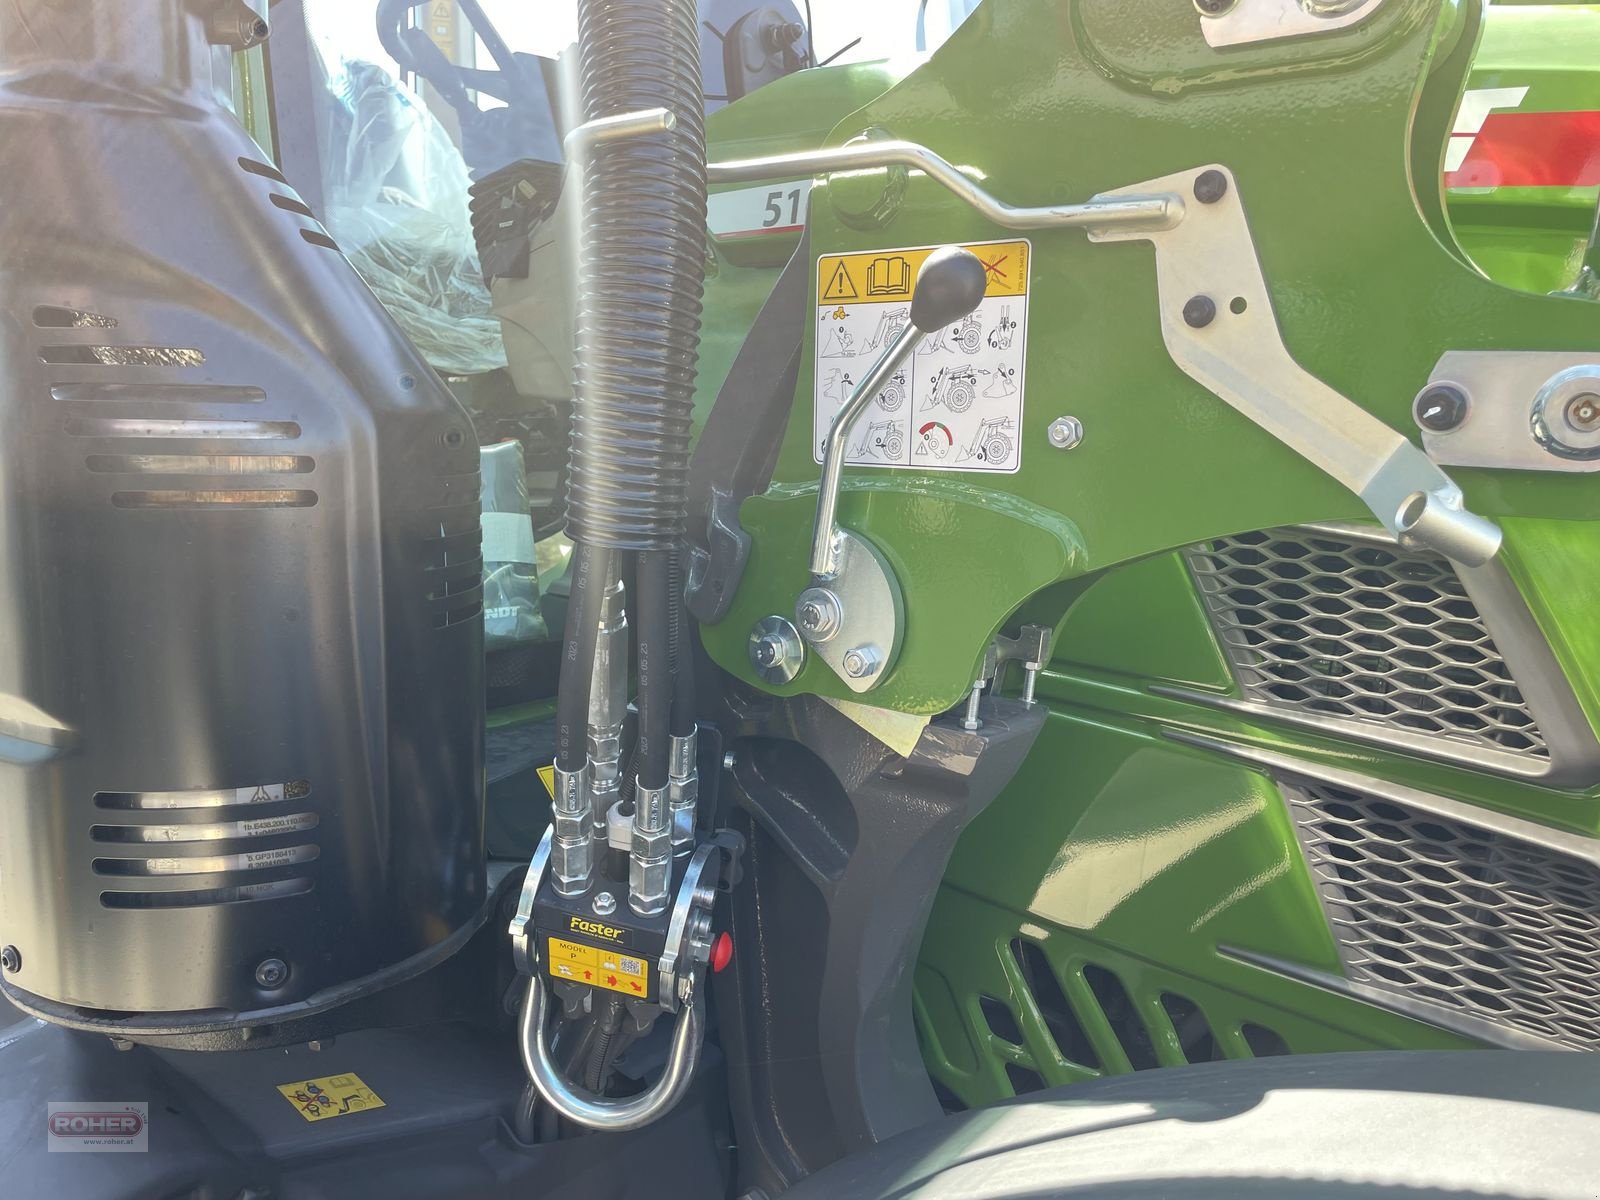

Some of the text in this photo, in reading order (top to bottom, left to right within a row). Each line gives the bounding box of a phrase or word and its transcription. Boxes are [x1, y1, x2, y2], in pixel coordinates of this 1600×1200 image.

[763, 189, 801, 227] 51
[570, 916, 623, 938] Faster
[560, 943, 587, 954] MODEL
